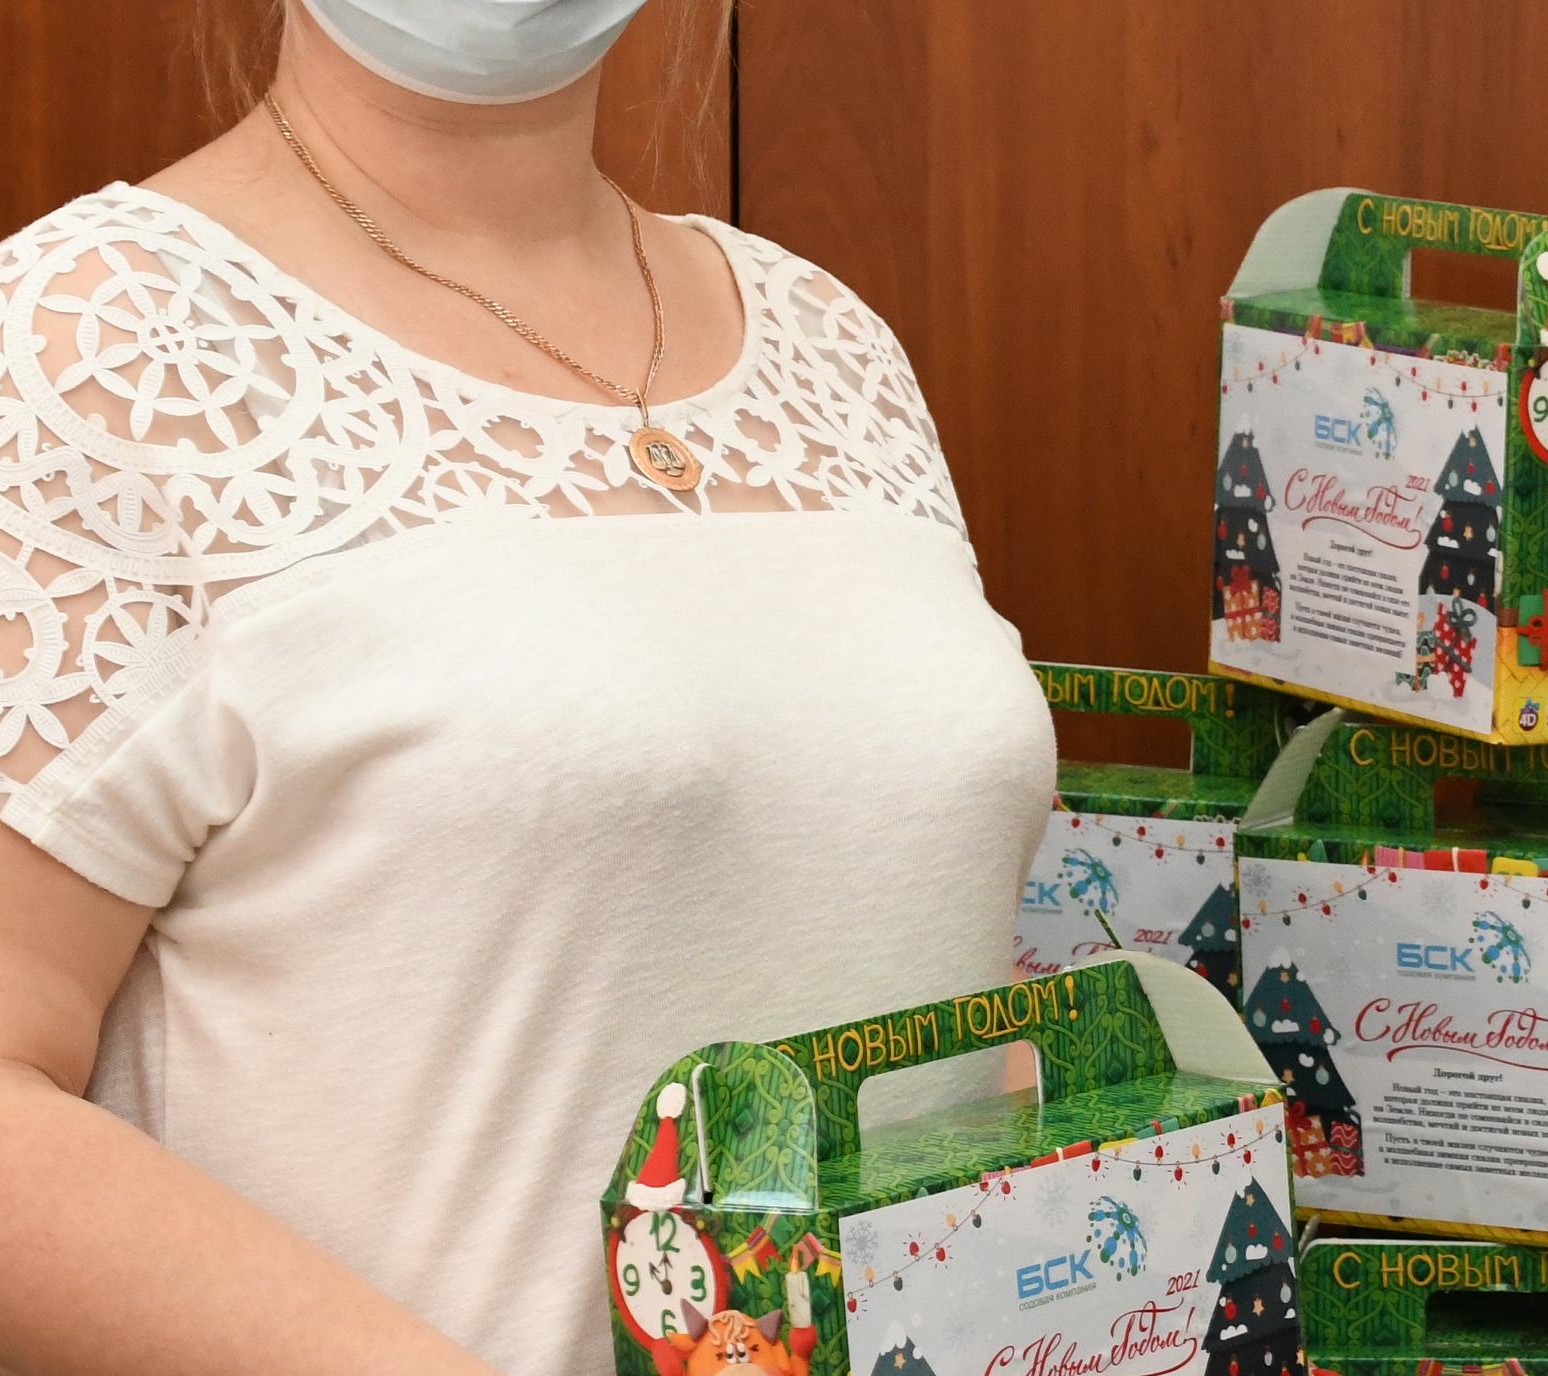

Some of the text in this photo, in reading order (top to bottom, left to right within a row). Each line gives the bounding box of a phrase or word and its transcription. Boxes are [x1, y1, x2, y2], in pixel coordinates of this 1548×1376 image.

[1357, 199, 1373, 234] С
[1382, 204, 1459, 241] НОВЫМ
[1314, 415, 1361, 446] БСК
[1284, 468, 1423, 531] С Новым Годом!
[1114, 670, 1236, 718] ГОДОМ!
[1350, 729, 1375, 767] С
[1392, 729, 1512, 770] НОВЫМ
[1397, 942, 1474, 972] БСК
[812, 975, 1079, 1082] НОВЫМ ГОДОМ!
[1354, 997, 1391, 1043] С
[1390, 1000, 1477, 1045] Новым
[1016, 1249, 1095, 1299] БСК
[1166, 1269, 1201, 1297] 2021
[1333, 1251, 1362, 1290] С
[1380, 1252, 1521, 1288] НОВЫМ
[1019, 1281, 1098, 1311] содовая компания
[1109, 1301, 1196, 1365] Годом!
